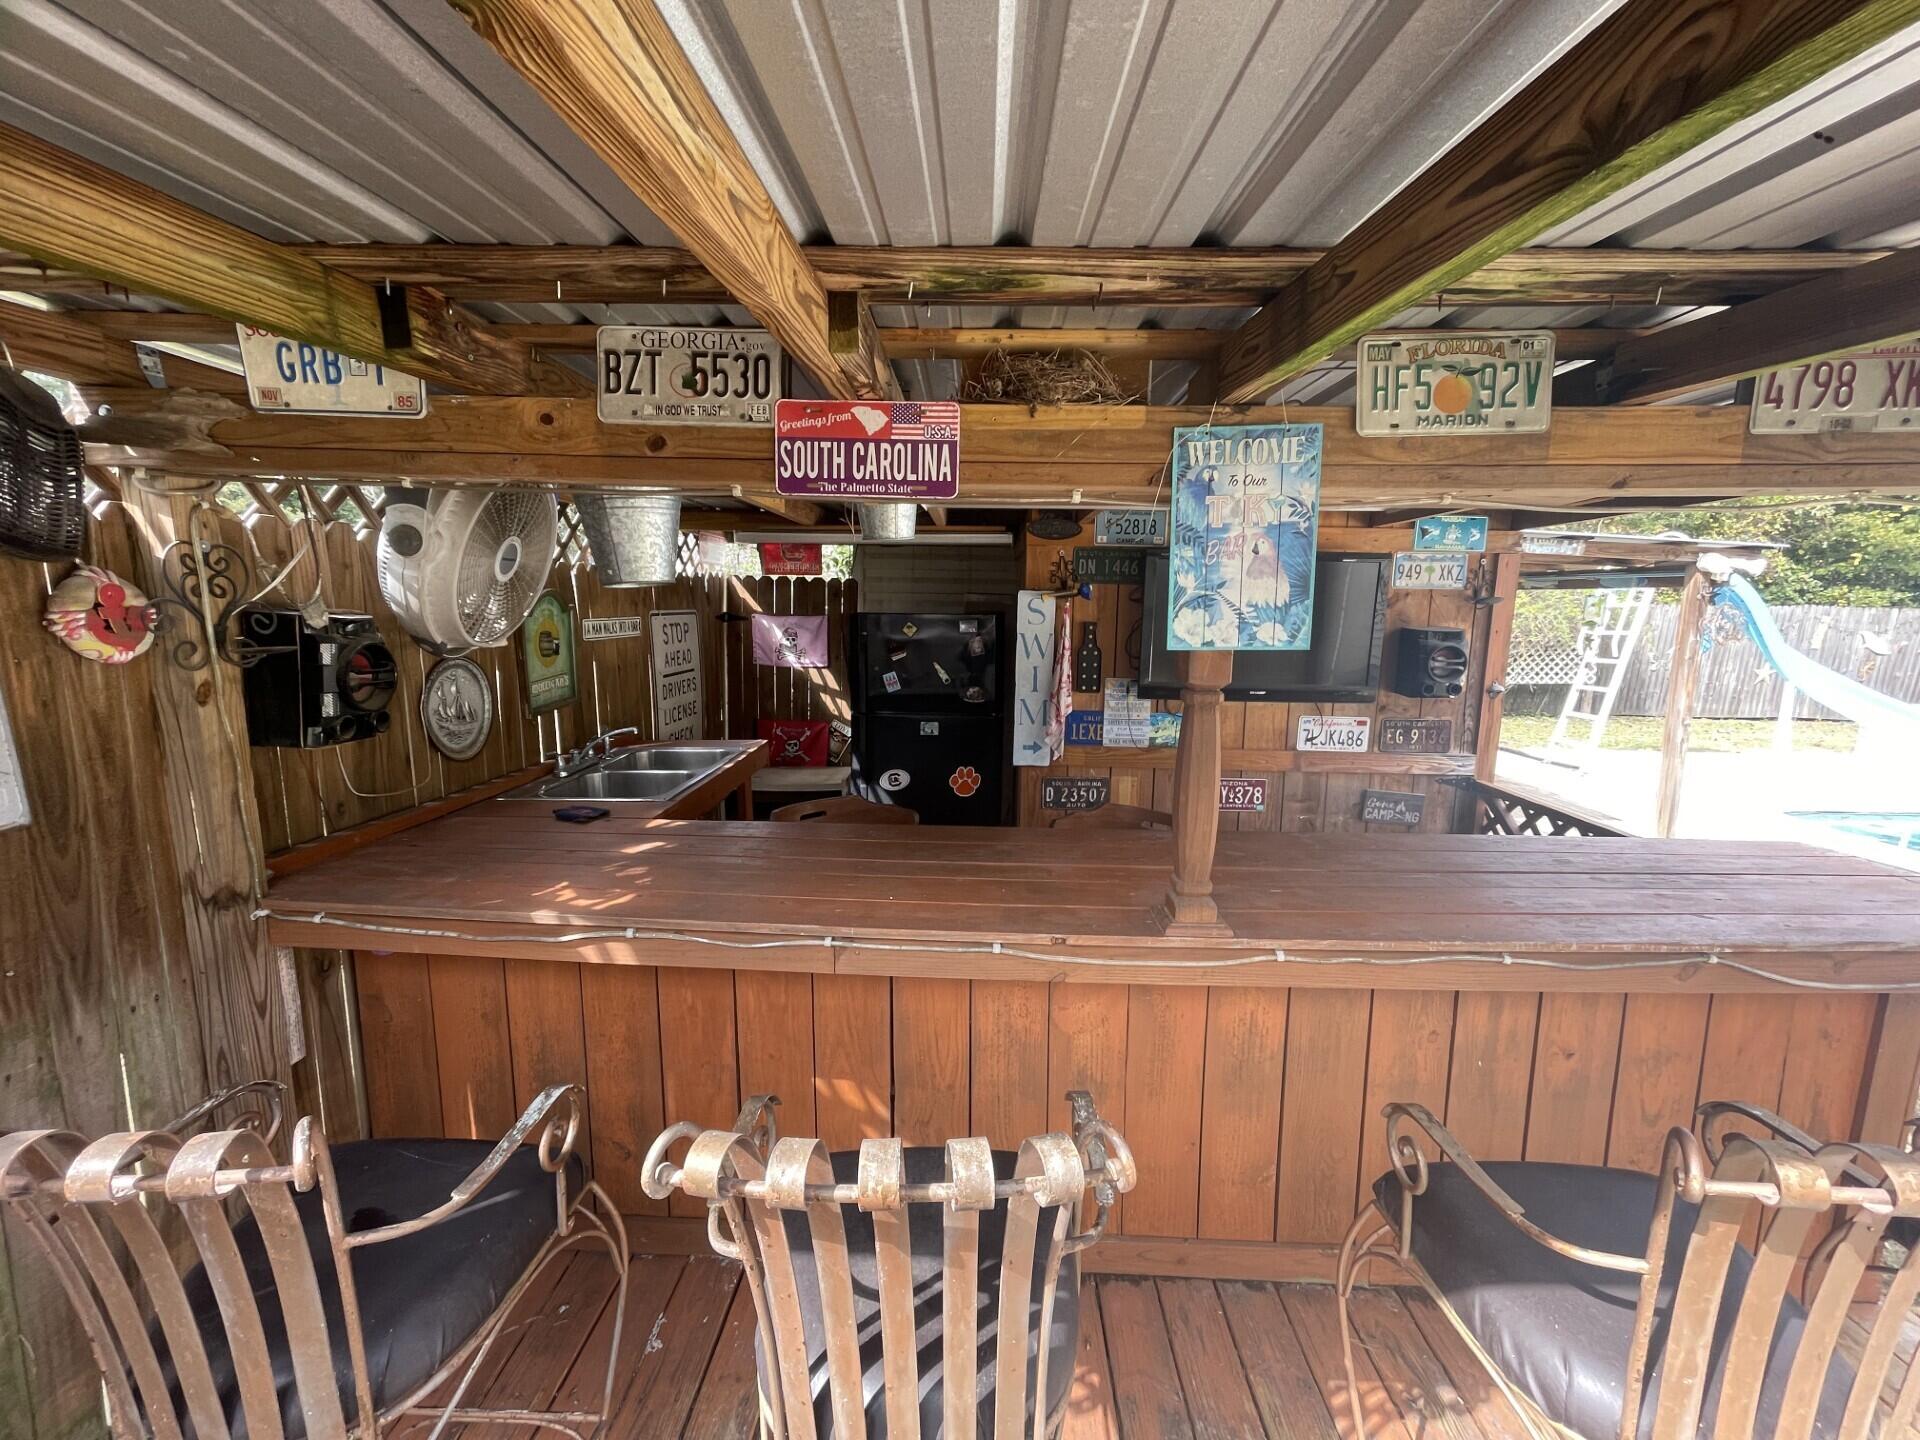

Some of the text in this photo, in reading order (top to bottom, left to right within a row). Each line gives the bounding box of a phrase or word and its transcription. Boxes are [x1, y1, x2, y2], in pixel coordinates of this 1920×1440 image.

[1369, 345, 1391, 361] MAY
[1406, 338, 1507, 363] FLORIDA
[1523, 340, 1534, 349] 01
[276, 341, 343, 385] GRB
[604, 349, 770, 399] BZT 5530
[1372, 361, 1542, 411] HF5 92V
[1764, 361, 1857, 410] 4798
[261, 389, 278, 400] NOV
[397, 396, 413, 408] 85
[655, 405, 721, 416] IN GOD WE TRUST
[751, 405, 767, 415] FEB
[780, 412, 852, 432] Greetings from
[1417, 414, 1488, 427] MARION
[924, 425, 956, 439] U.S.A.
[1187, 436, 1306, 466] WELCOME
[780, 440, 952, 482] SOUTH CAROLINA
[818, 481, 913, 493] The Palmetto State
[1227, 473, 1268, 487] To Our
[1079, 559, 1138, 576] DN 1446
[1398, 564, 1464, 581] 949 XKZ
[662, 622, 689, 645] STOP
[664, 649, 692, 669] AHEAD
[1019, 597, 1053, 727] SWIM
[662, 677, 697, 700] DRIVERS
[664, 700, 698, 726] LICENSE
[669, 725, 694, 740] CHECK
[1303, 729, 1364, 747] 7LJK486
[1387, 729, 1447, 744] EG 9136
[1061, 788, 1106, 802] 23507
[1235, 787, 1262, 804] 378
